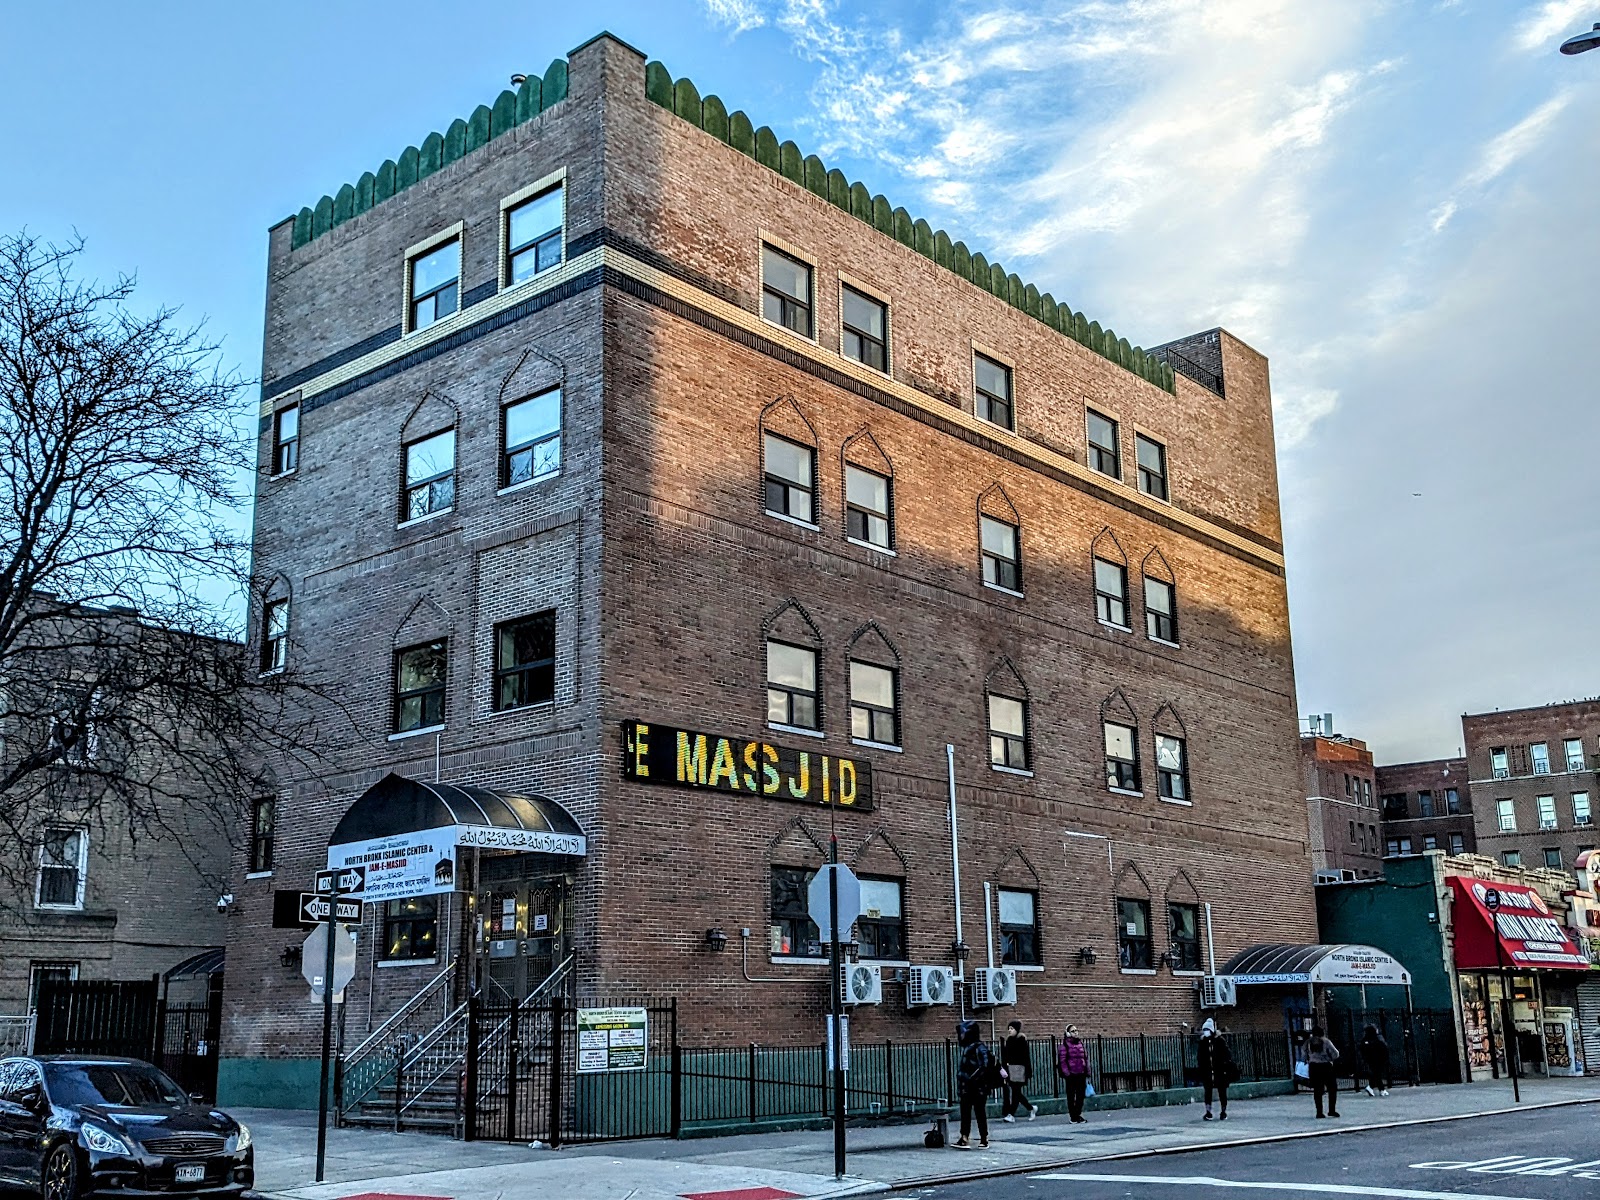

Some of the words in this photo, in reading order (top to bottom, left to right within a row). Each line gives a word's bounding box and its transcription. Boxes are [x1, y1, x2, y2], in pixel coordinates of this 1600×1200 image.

[676, 731, 857, 805] MASJID
[344, 854, 363, 866] NORTH
[383, 848, 406, 860] ISLAMIC
[406, 845, 428, 856] CENTER
[428, 844, 434, 853] &
[342, 875, 358, 887] WAY
[310, 903, 329, 914] ONE
[336, 905, 355, 916] WAY
[1507, 891, 1532, 909] STOP
[1517, 916, 1569, 943] MARKET
